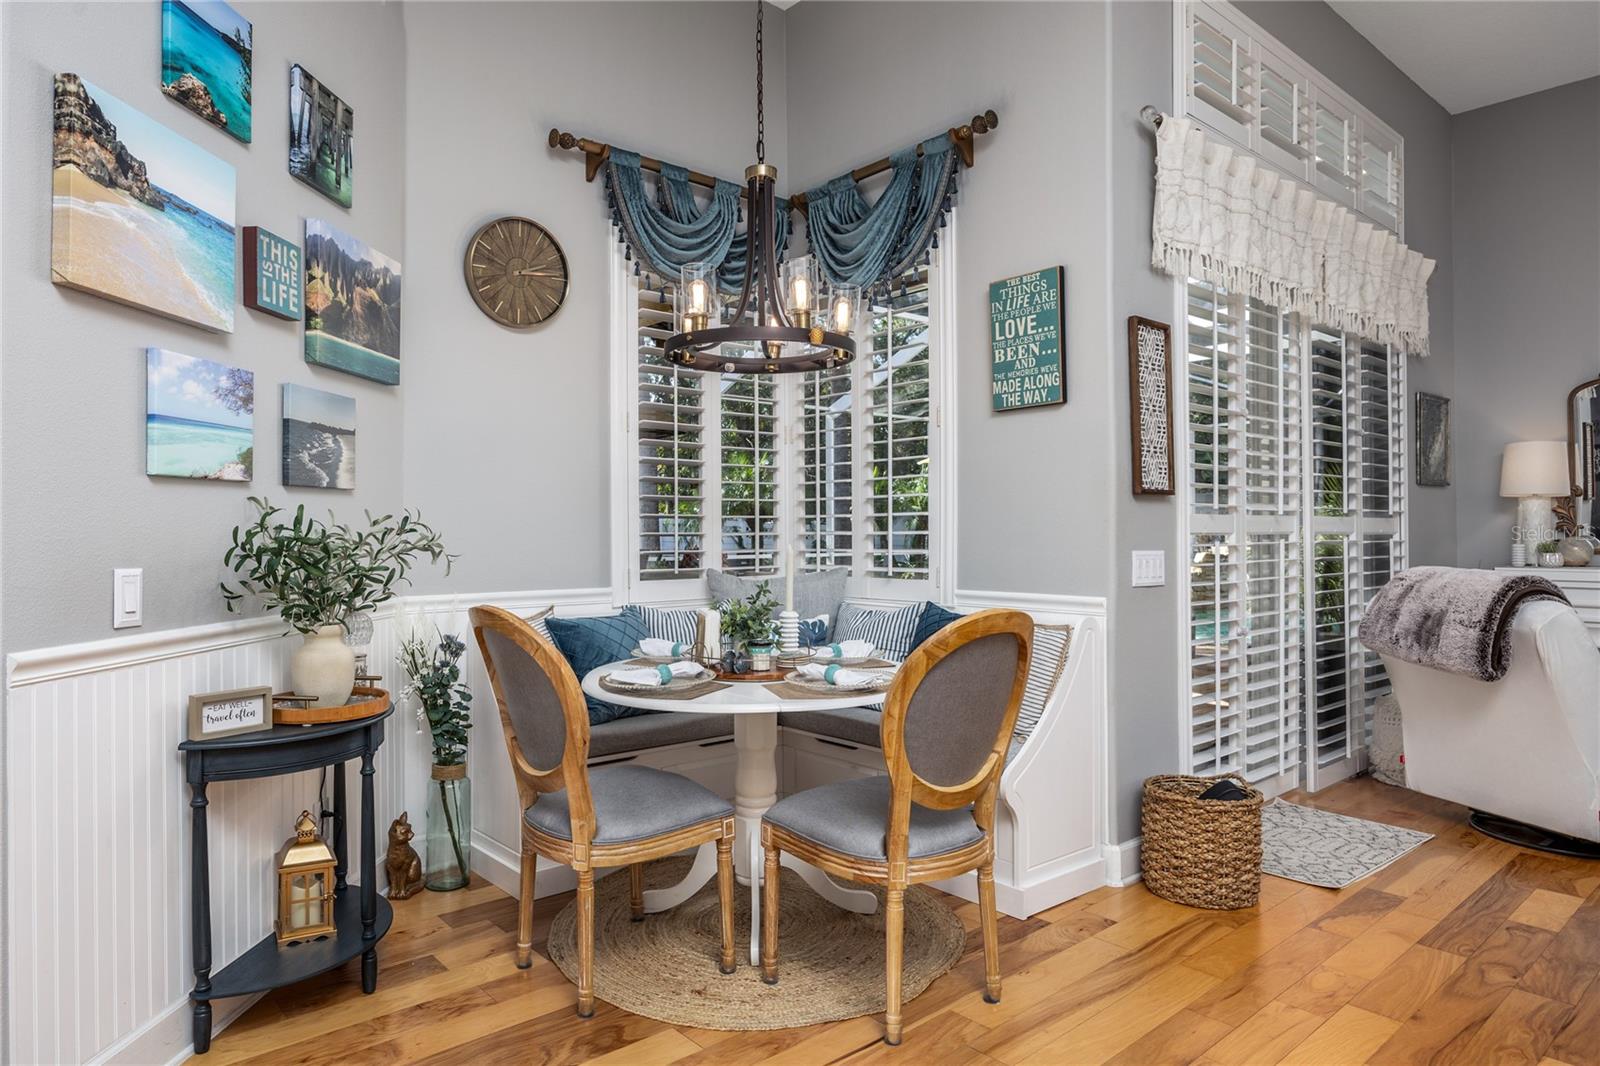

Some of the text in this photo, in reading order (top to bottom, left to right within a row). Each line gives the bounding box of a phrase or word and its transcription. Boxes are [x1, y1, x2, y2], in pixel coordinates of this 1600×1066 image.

[260, 235, 297, 271] THIS
[263, 260, 297, 288] IS THE
[1006, 272, 1041, 287] THE BEST
[263, 278, 298, 312] LIFE
[1000, 279, 1047, 300] THINGS
[992, 288, 1057, 313] IN LIFE ARE
[991, 301, 1057, 322] THE PEOPLE WE
[995, 314, 1055, 341] LOVE...
[993, 340, 1006, 349] THE
[1007, 335, 1033, 347] PLACES
[994, 341, 1057, 364] BEEN...
[994, 372, 1006, 380] THE
[1007, 367, 1039, 378] MEMORIES
[1014, 357, 1036, 370] AND
[992, 372, 1060, 395] MADE ALONG
[1001, 388, 1051, 408] THE WAY.
[206, 708, 256, 724] travel often
